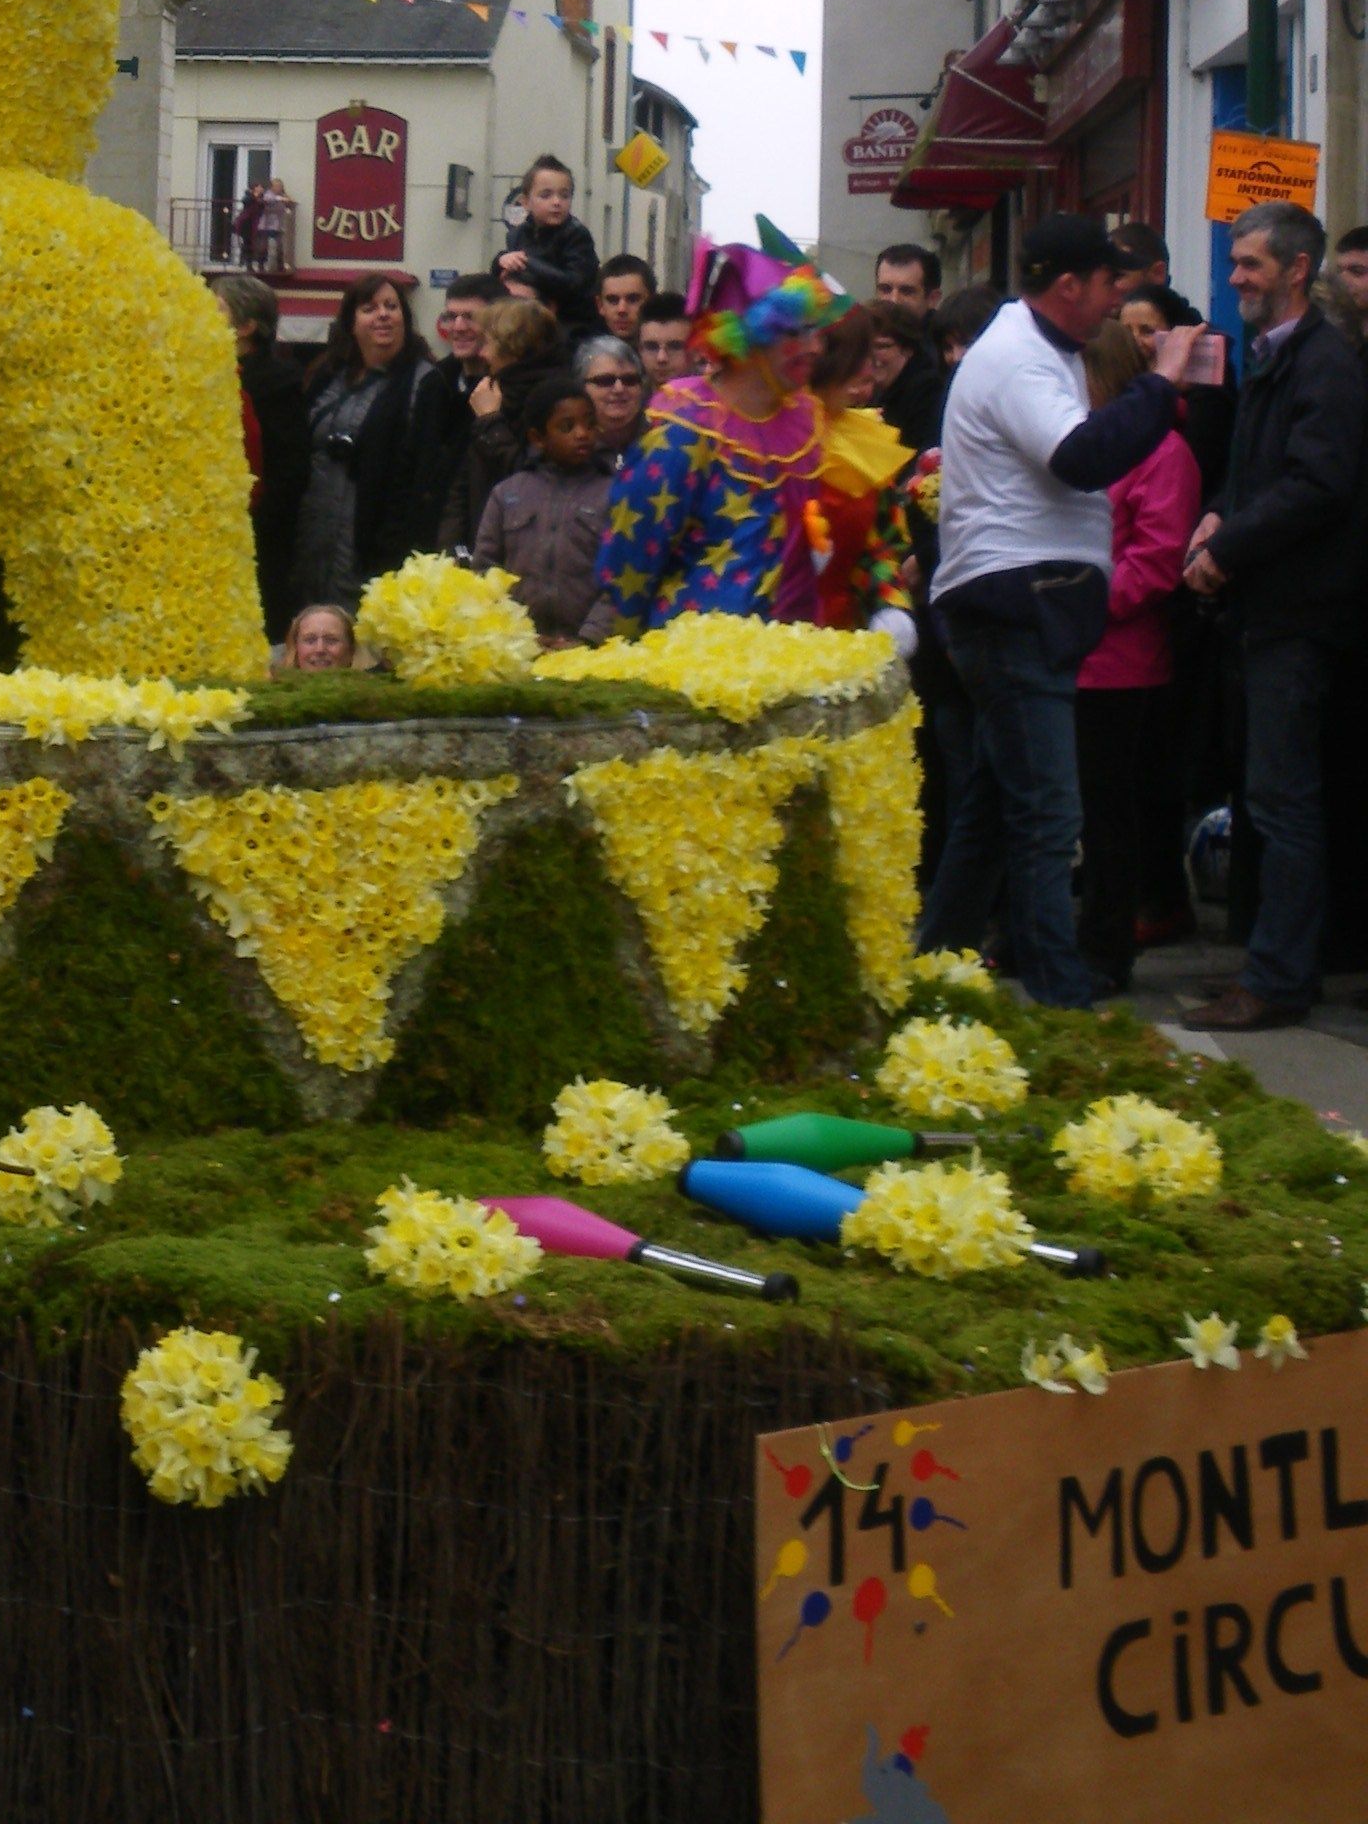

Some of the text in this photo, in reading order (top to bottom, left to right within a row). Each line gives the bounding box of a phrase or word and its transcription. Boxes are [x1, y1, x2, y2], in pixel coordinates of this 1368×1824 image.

[322, 124, 401, 163] BAR
[1216, 167, 1316, 189] STATIONNEMENT
[1236, 183, 1292, 199] INTERDIT
[315, 203, 402, 241] JEUX
[800, 1462, 907, 1586] 14
